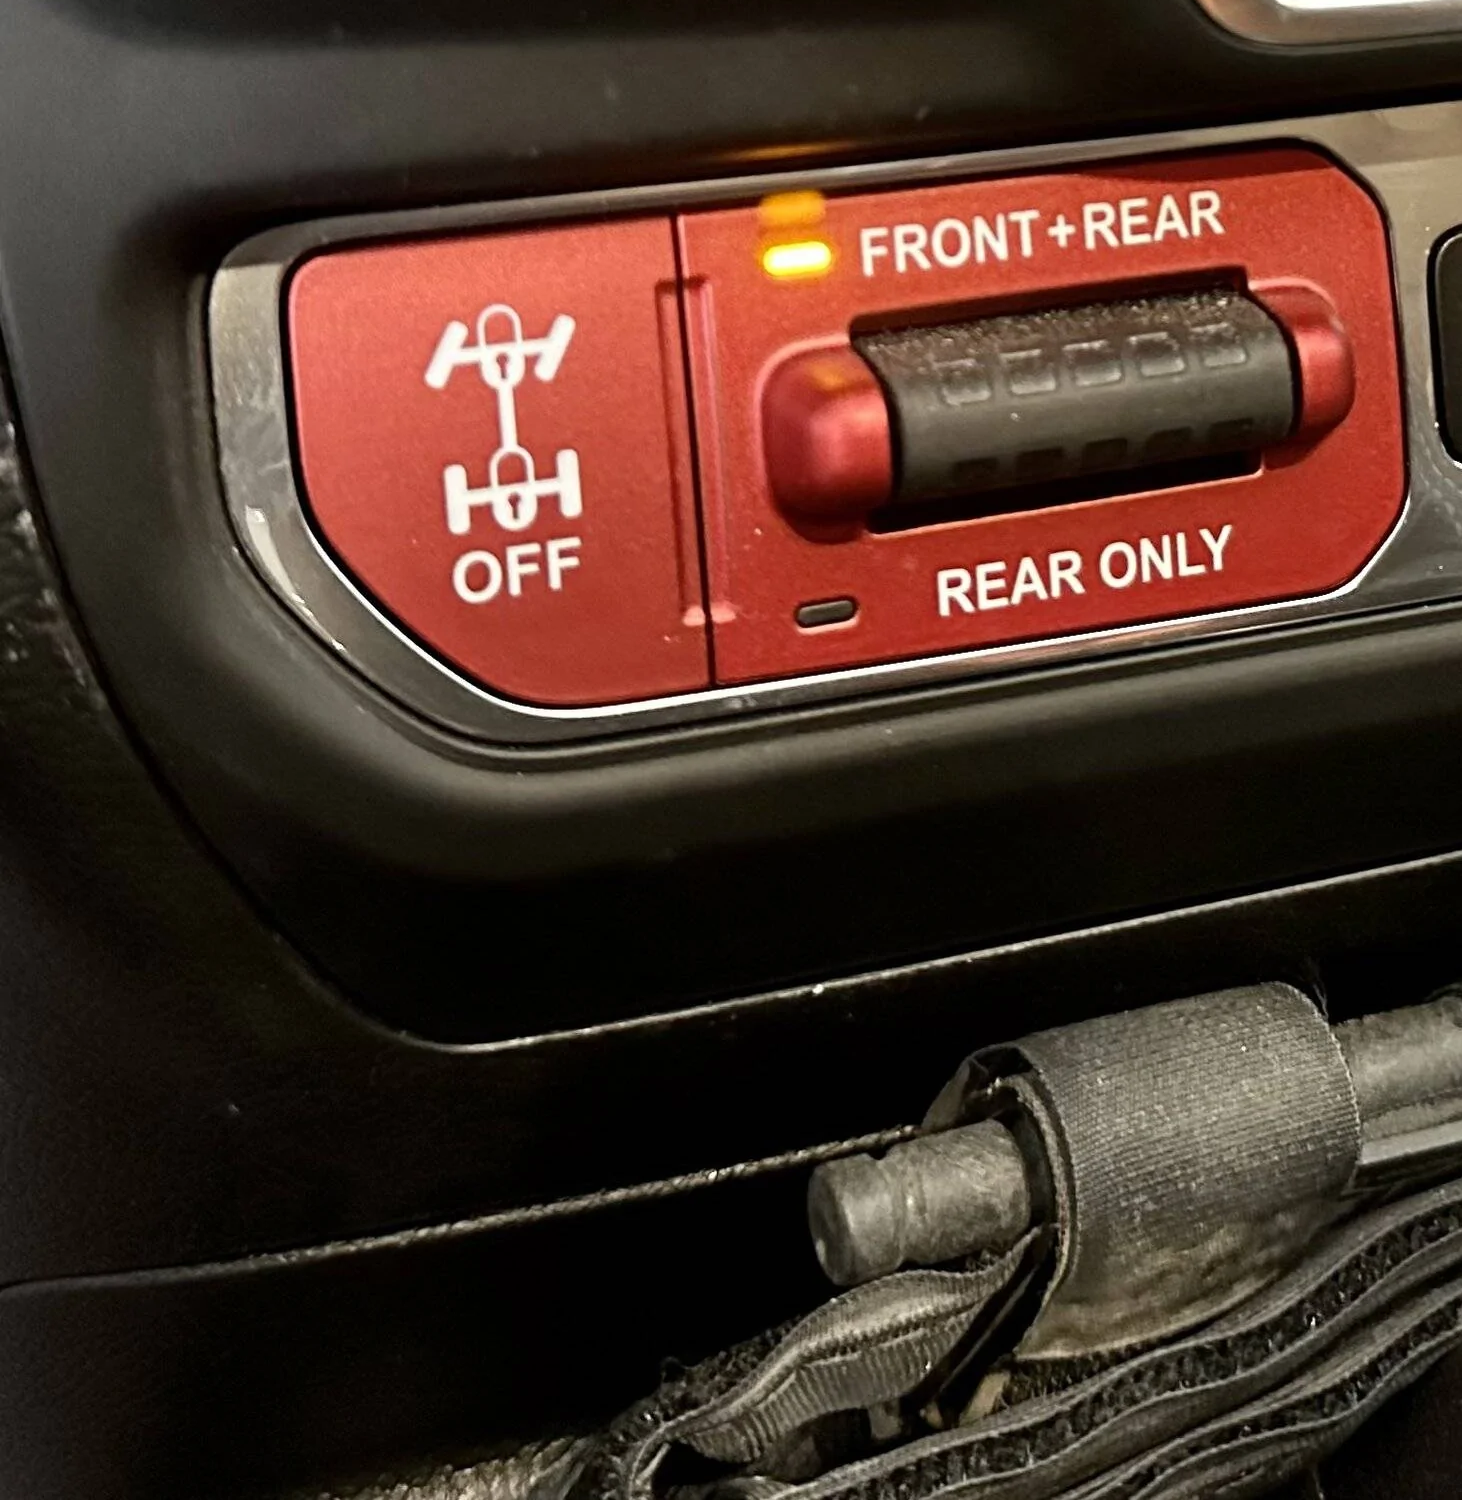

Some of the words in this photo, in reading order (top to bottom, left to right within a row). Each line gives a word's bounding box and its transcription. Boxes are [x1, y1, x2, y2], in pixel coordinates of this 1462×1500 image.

[453, 536, 581, 604] OFF
[936, 548, 1084, 616] REAR
[1100, 525, 1235, 588] ONLY
